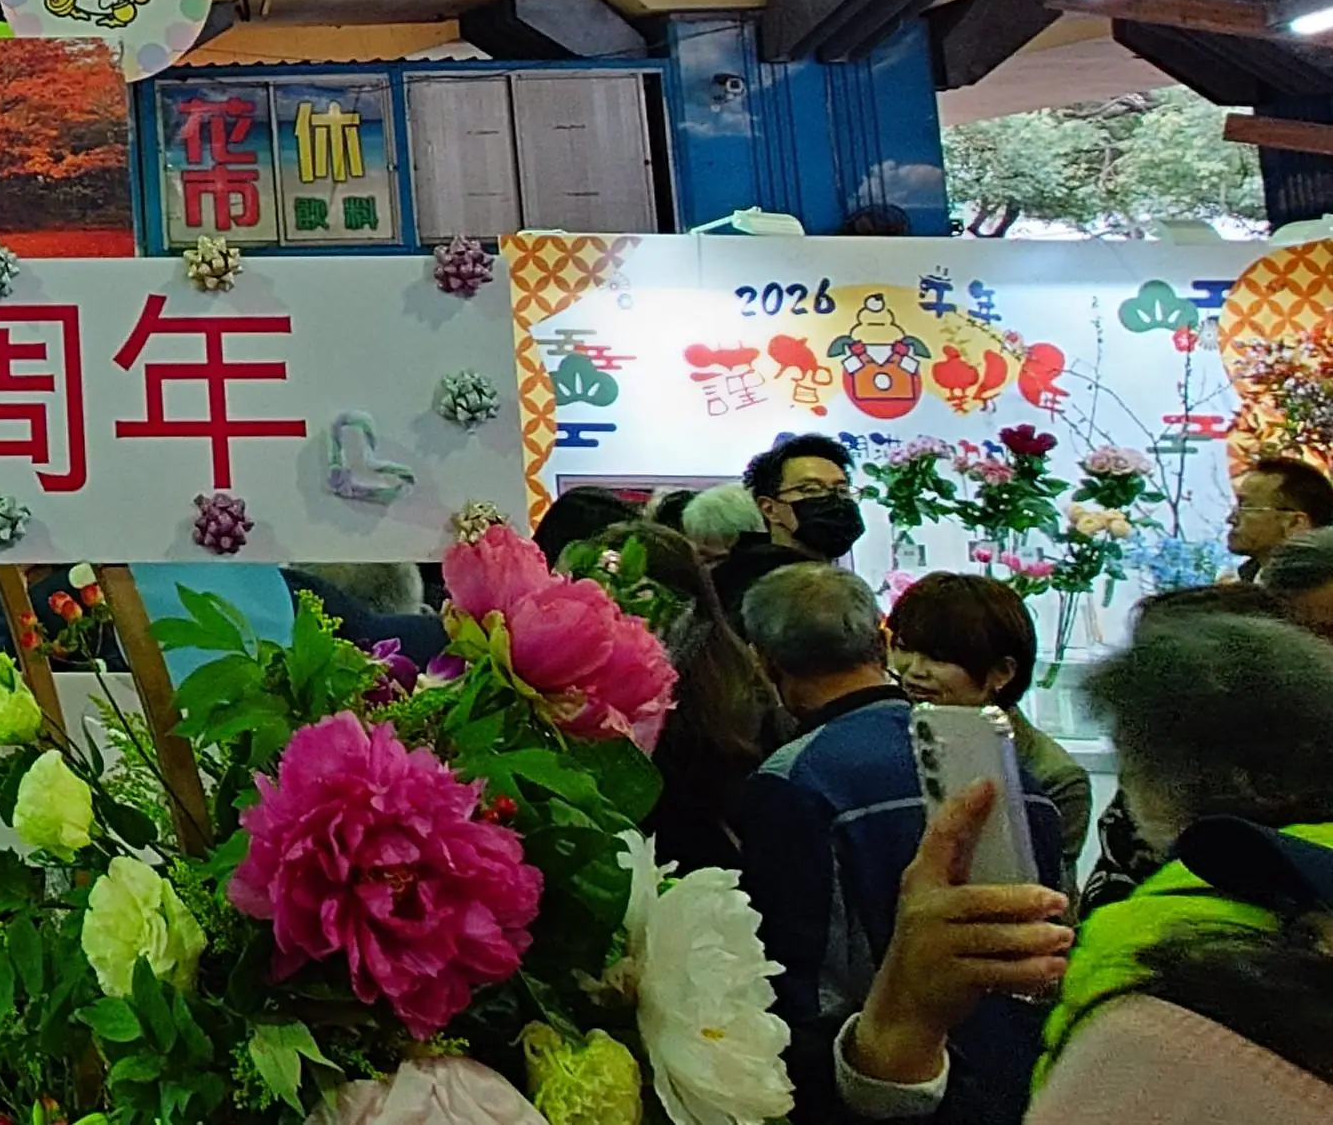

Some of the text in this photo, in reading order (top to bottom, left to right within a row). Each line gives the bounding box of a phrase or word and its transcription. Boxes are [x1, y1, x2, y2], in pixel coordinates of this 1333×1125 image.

[177, 97, 261, 232] 花市
[294, 196, 379, 232] 飲料
[735, 277, 837, 317] 2026
